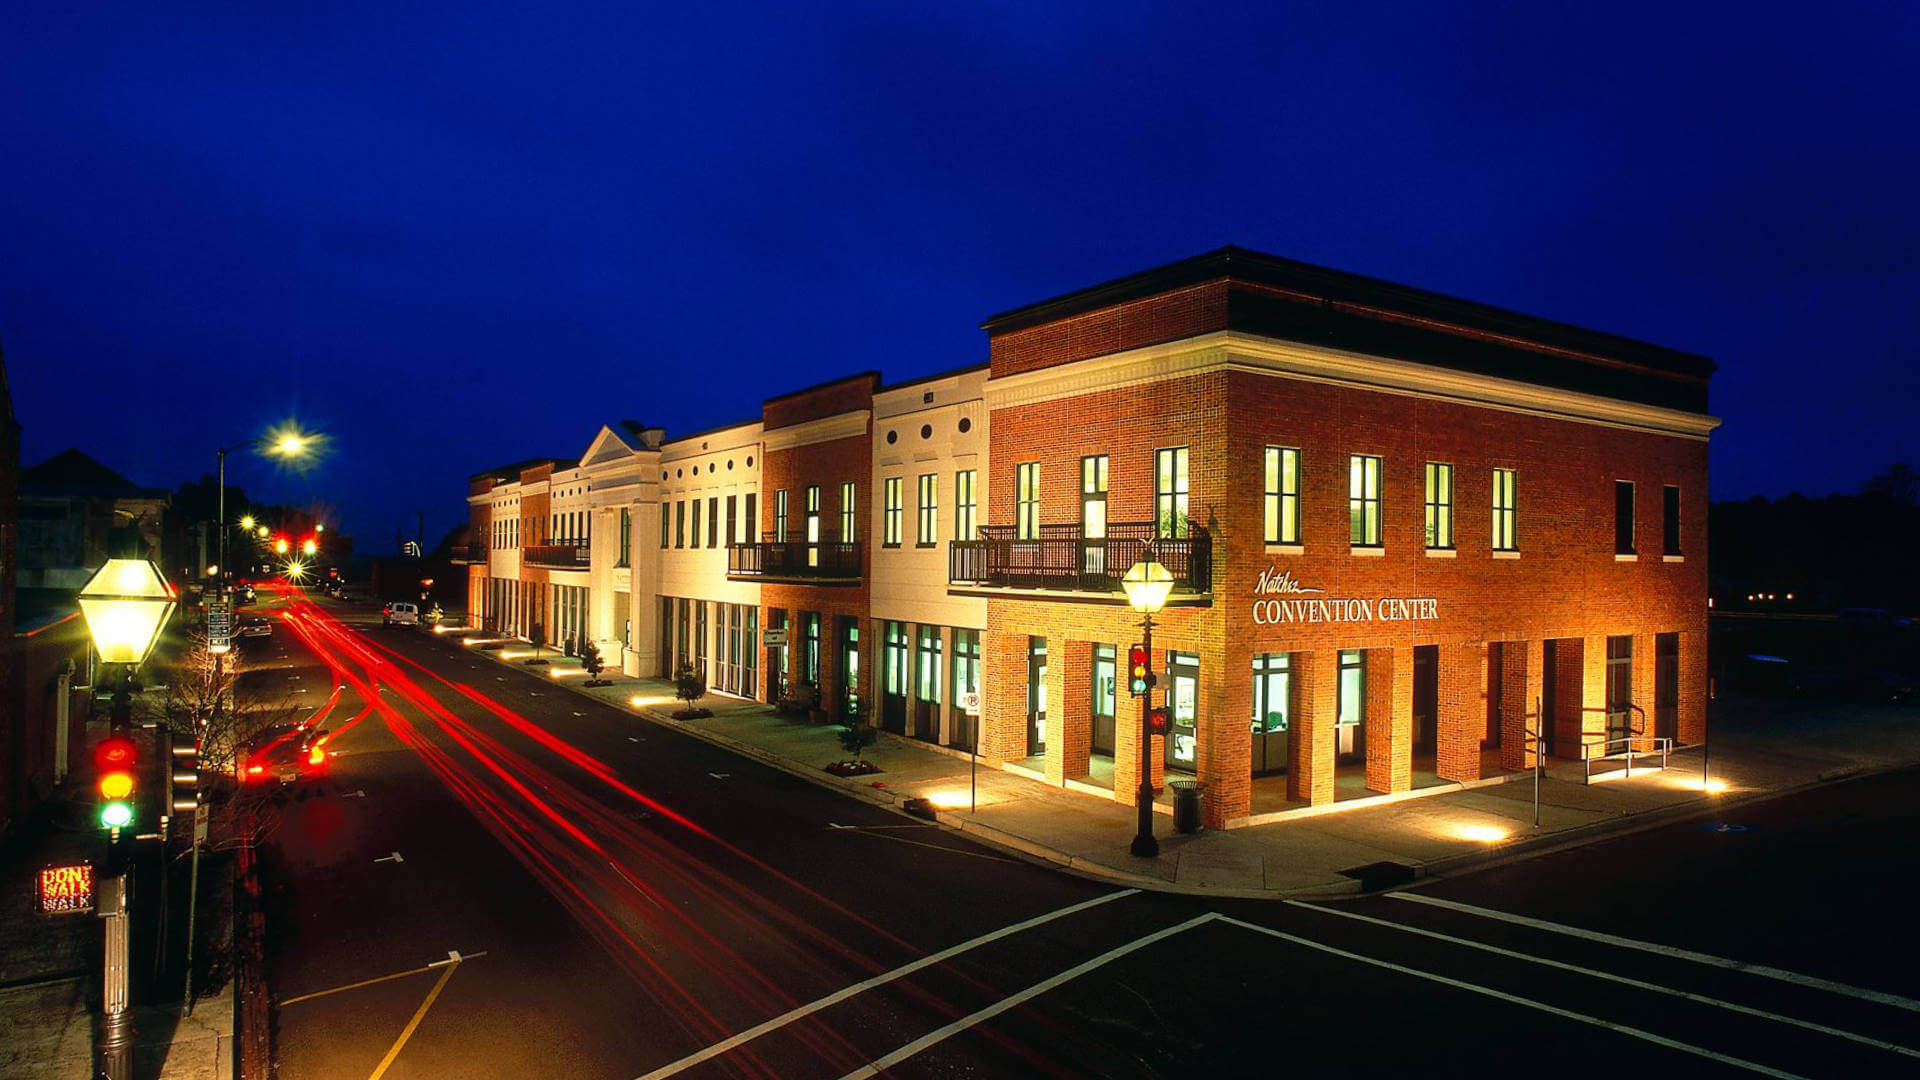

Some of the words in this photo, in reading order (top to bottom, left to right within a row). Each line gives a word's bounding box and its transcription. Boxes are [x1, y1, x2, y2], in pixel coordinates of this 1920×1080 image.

[1254, 566, 1325, 594] Natchez
[1252, 599, 1372, 624] CONVENTION
[1377, 598, 1439, 621] CENTER
[43, 880, 91, 899] WALK
[43, 896, 90, 911] WALK
